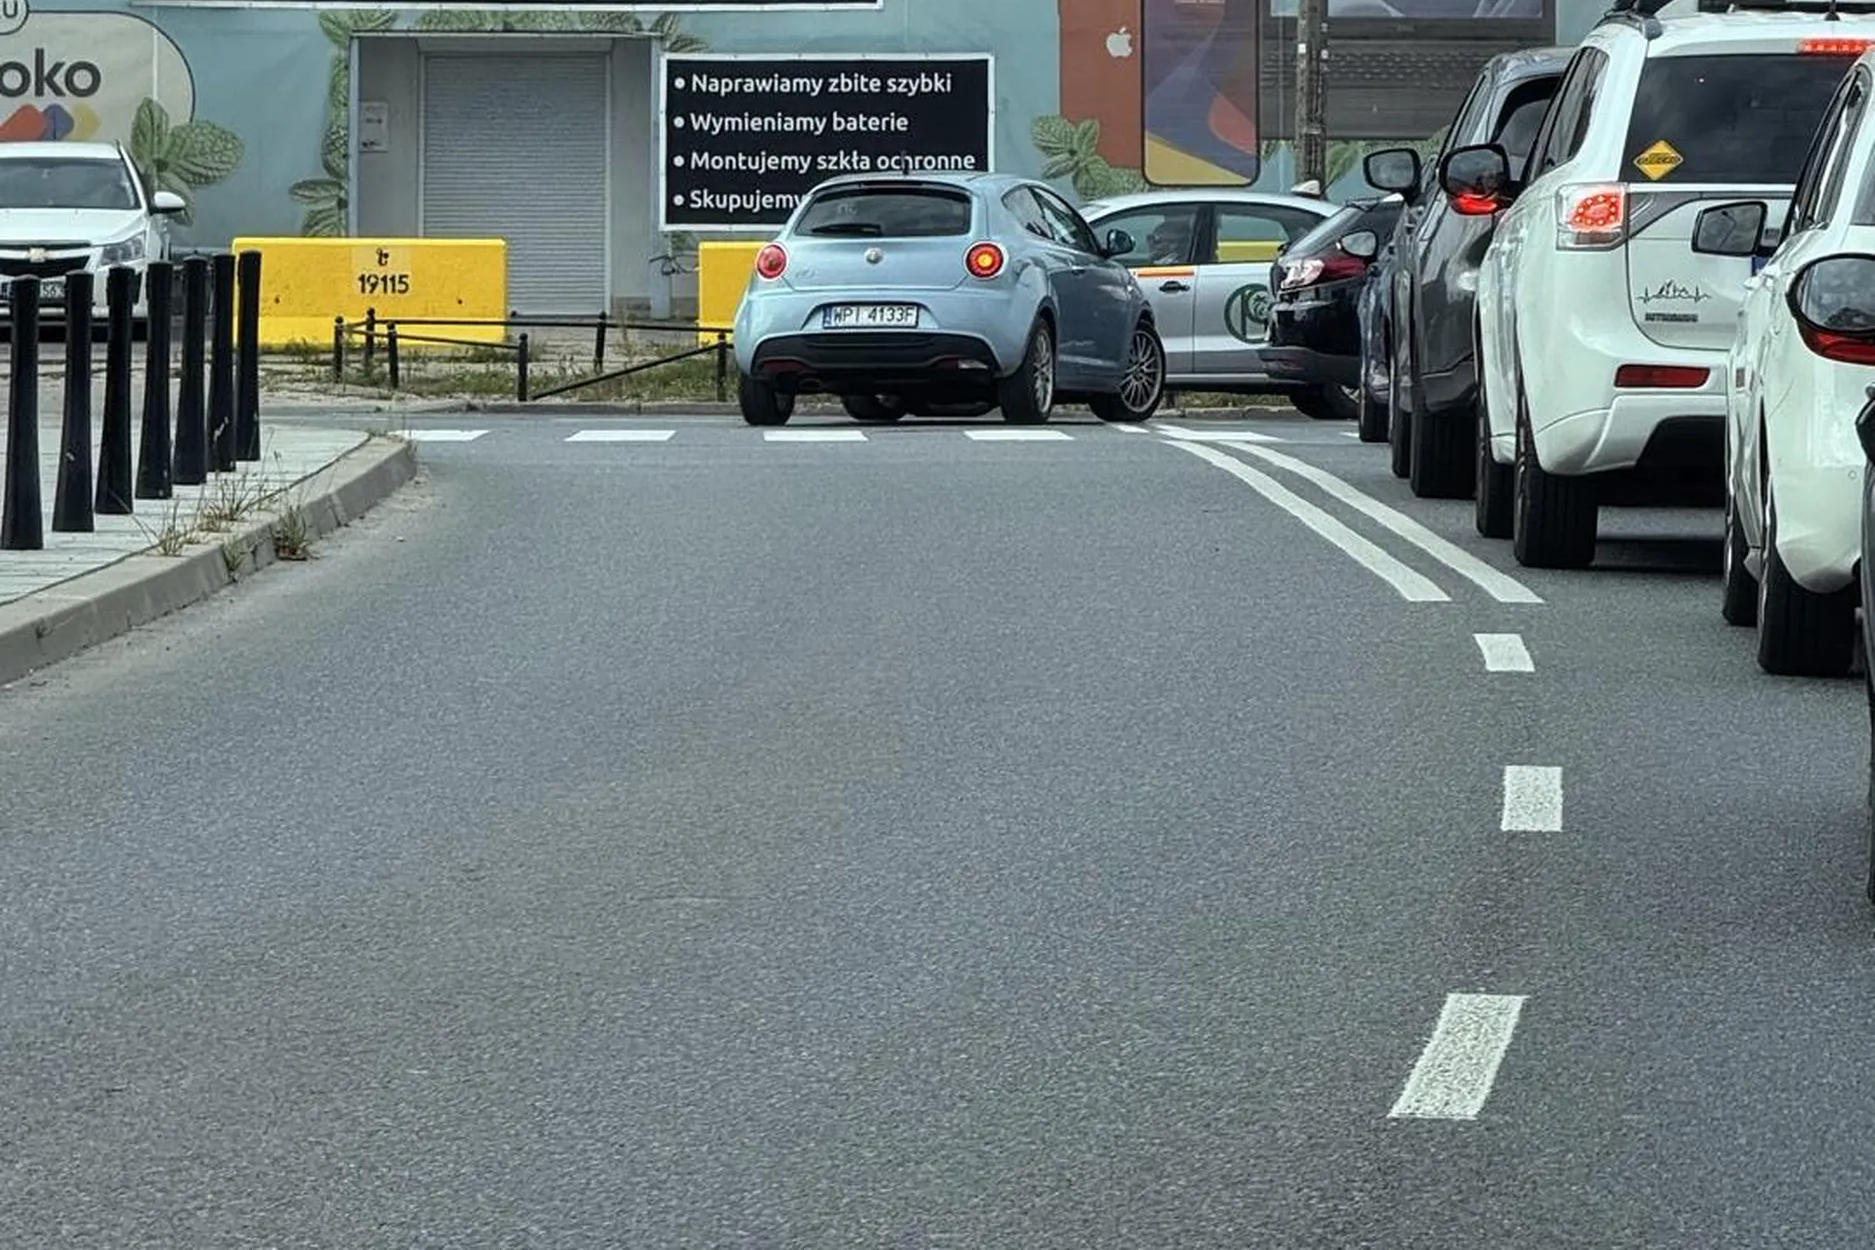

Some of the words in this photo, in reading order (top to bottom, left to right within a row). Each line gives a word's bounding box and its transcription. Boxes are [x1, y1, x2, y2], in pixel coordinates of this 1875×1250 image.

[691, 74, 823, 96] Naprawiamy
[828, 74, 882, 92] zbite
[886, 74, 952, 97] szybki
[690, 113, 827, 135] Wymieniamy
[832, 113, 909, 132] baterie
[690, 151, 812, 174] Montujemy
[816, 151, 871, 170] szkła
[876, 151, 976, 170] ochronne
[358, 274, 409, 294] 19115
[867, 307, 914, 323] 4133F
